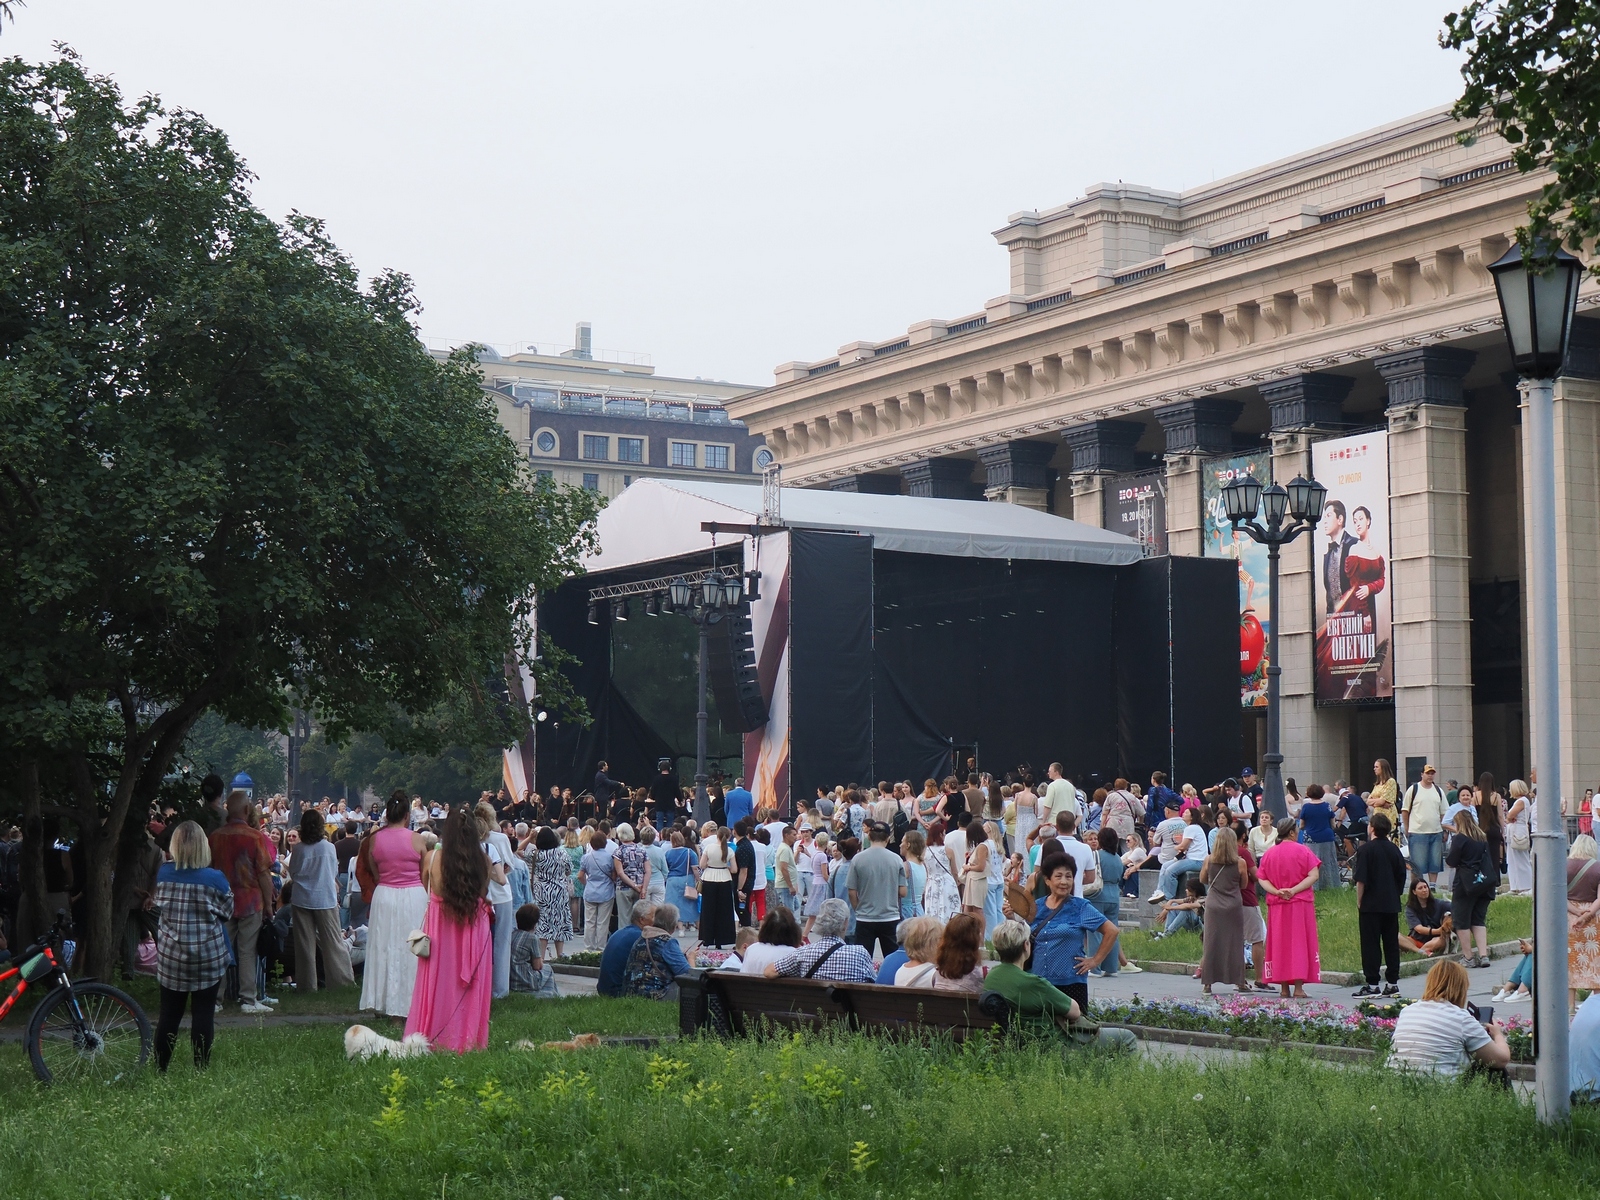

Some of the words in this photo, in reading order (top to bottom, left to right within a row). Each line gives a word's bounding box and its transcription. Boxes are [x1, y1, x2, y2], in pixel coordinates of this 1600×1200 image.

[1338, 475, 1345, 485] 12
[1345, 472, 1362, 484] ИЮЛЯ
[1129, 511, 1136, 521] 20
[1326, 613, 1363, 637] ЕВГЕНИЙ
[1332, 633, 1376, 661] ОНЕГИН
